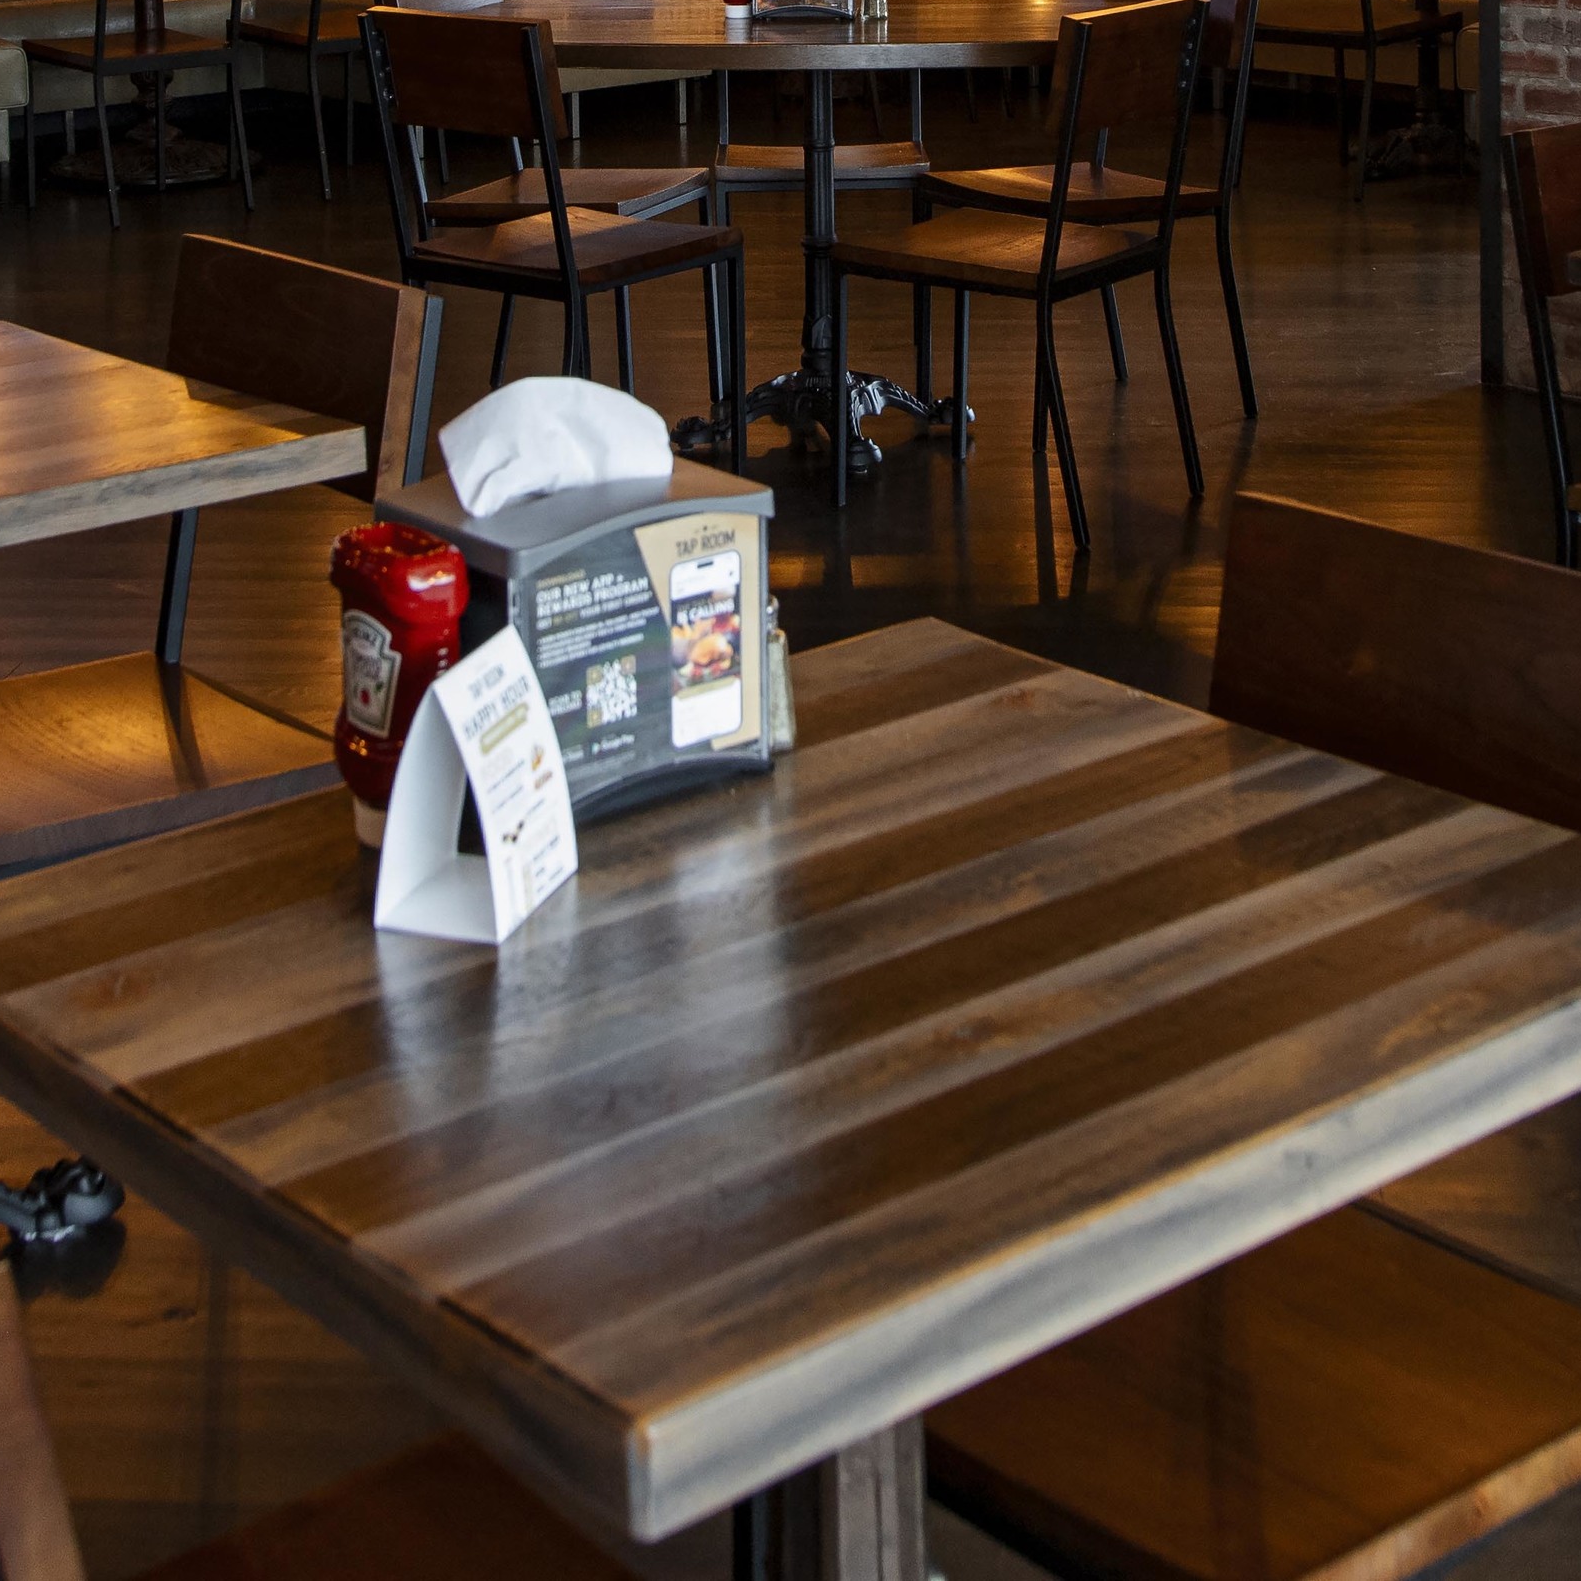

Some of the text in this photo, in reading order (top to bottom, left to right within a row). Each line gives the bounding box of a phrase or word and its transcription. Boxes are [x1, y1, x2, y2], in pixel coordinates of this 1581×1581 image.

[676, 529, 736, 557] TAP ROOM
[563, 579, 590, 597] NEW
[592, 573, 615, 590] APP
